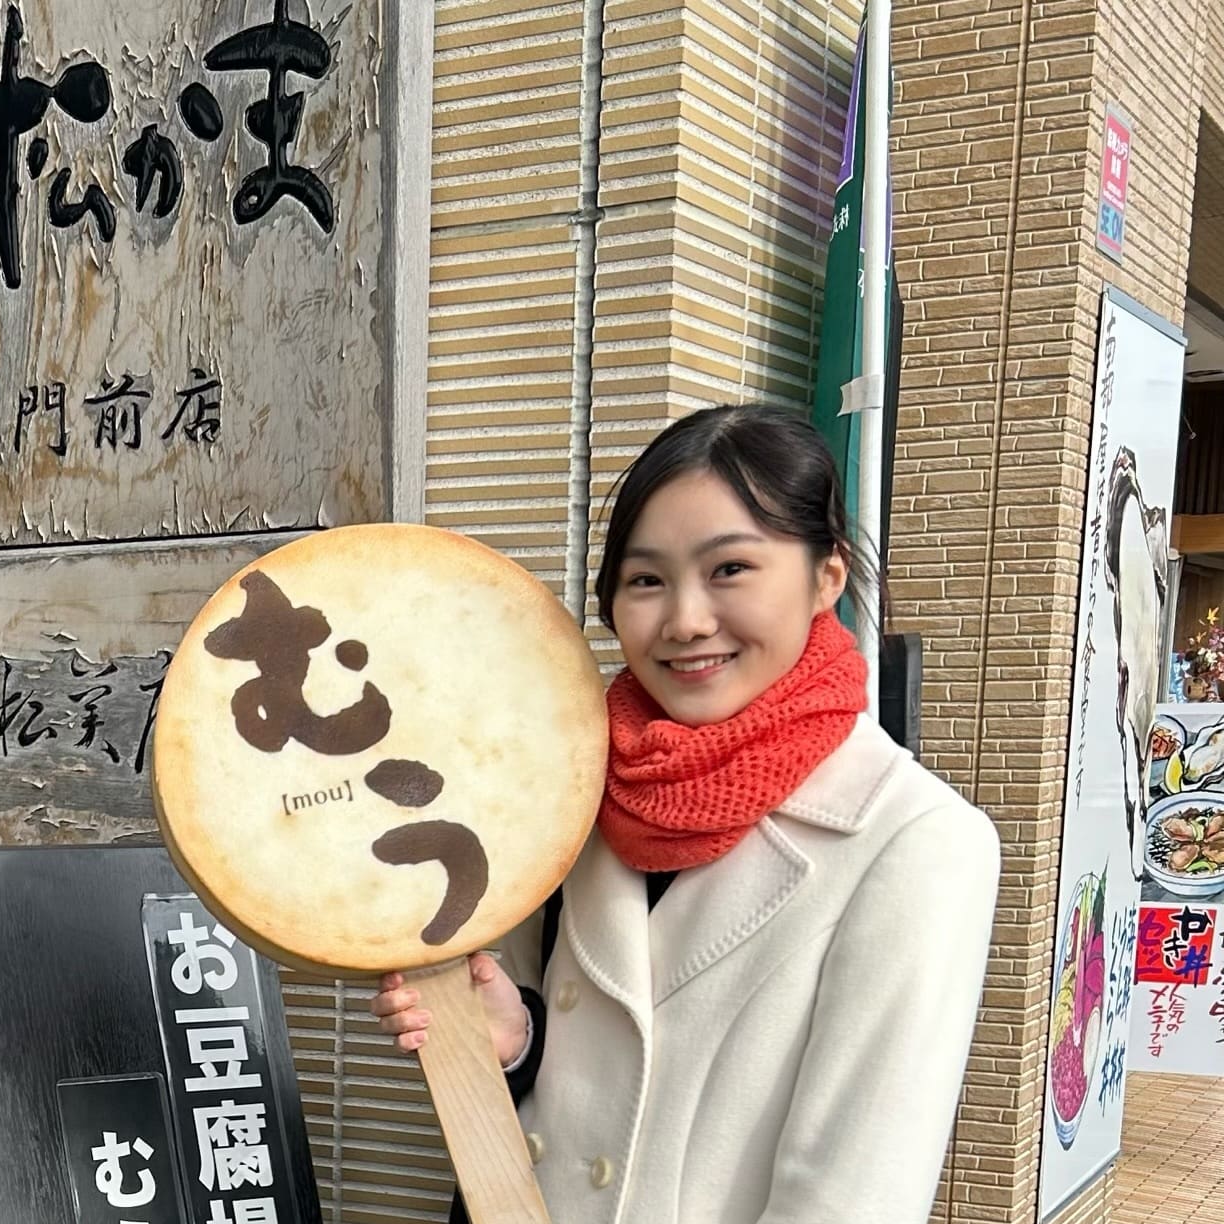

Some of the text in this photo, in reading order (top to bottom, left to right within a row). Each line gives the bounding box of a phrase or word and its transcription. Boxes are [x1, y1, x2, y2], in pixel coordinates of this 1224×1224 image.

[14, 368, 224, 456] 門前店
[204, 569, 489, 946] むう
